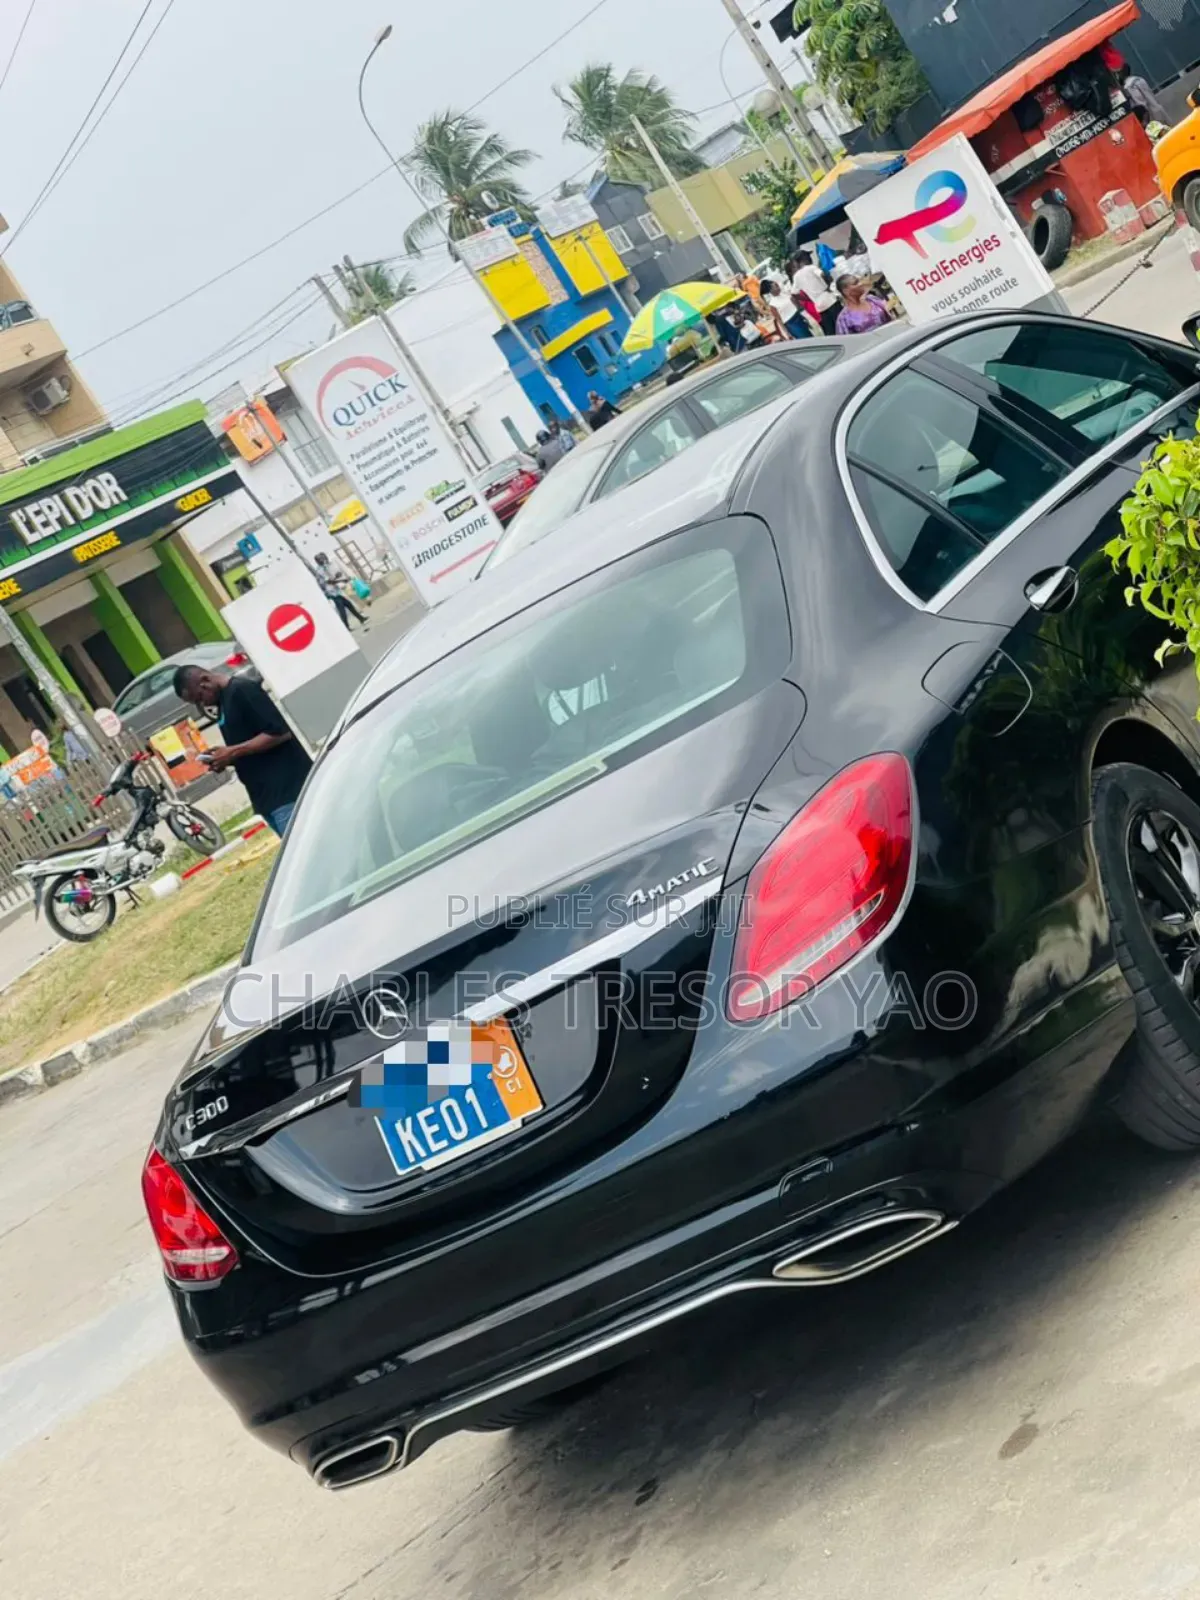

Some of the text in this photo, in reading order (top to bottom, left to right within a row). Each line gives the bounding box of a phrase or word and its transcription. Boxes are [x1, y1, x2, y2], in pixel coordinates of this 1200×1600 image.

[906, 234, 1001, 294] TotalEnergies
[932, 265, 1003, 313] vous souhaite
[988, 276, 1020, 300] route
[333, 372, 408, 427] QUICK
[9, 471, 128, 546] L'EPI D'OR
[411, 516, 445, 540] BOSCH
[411, 513, 490, 569] BRIDGESTONE
[626, 857, 720, 908] 4MATIC
[185, 1095, 230, 1131] C300
